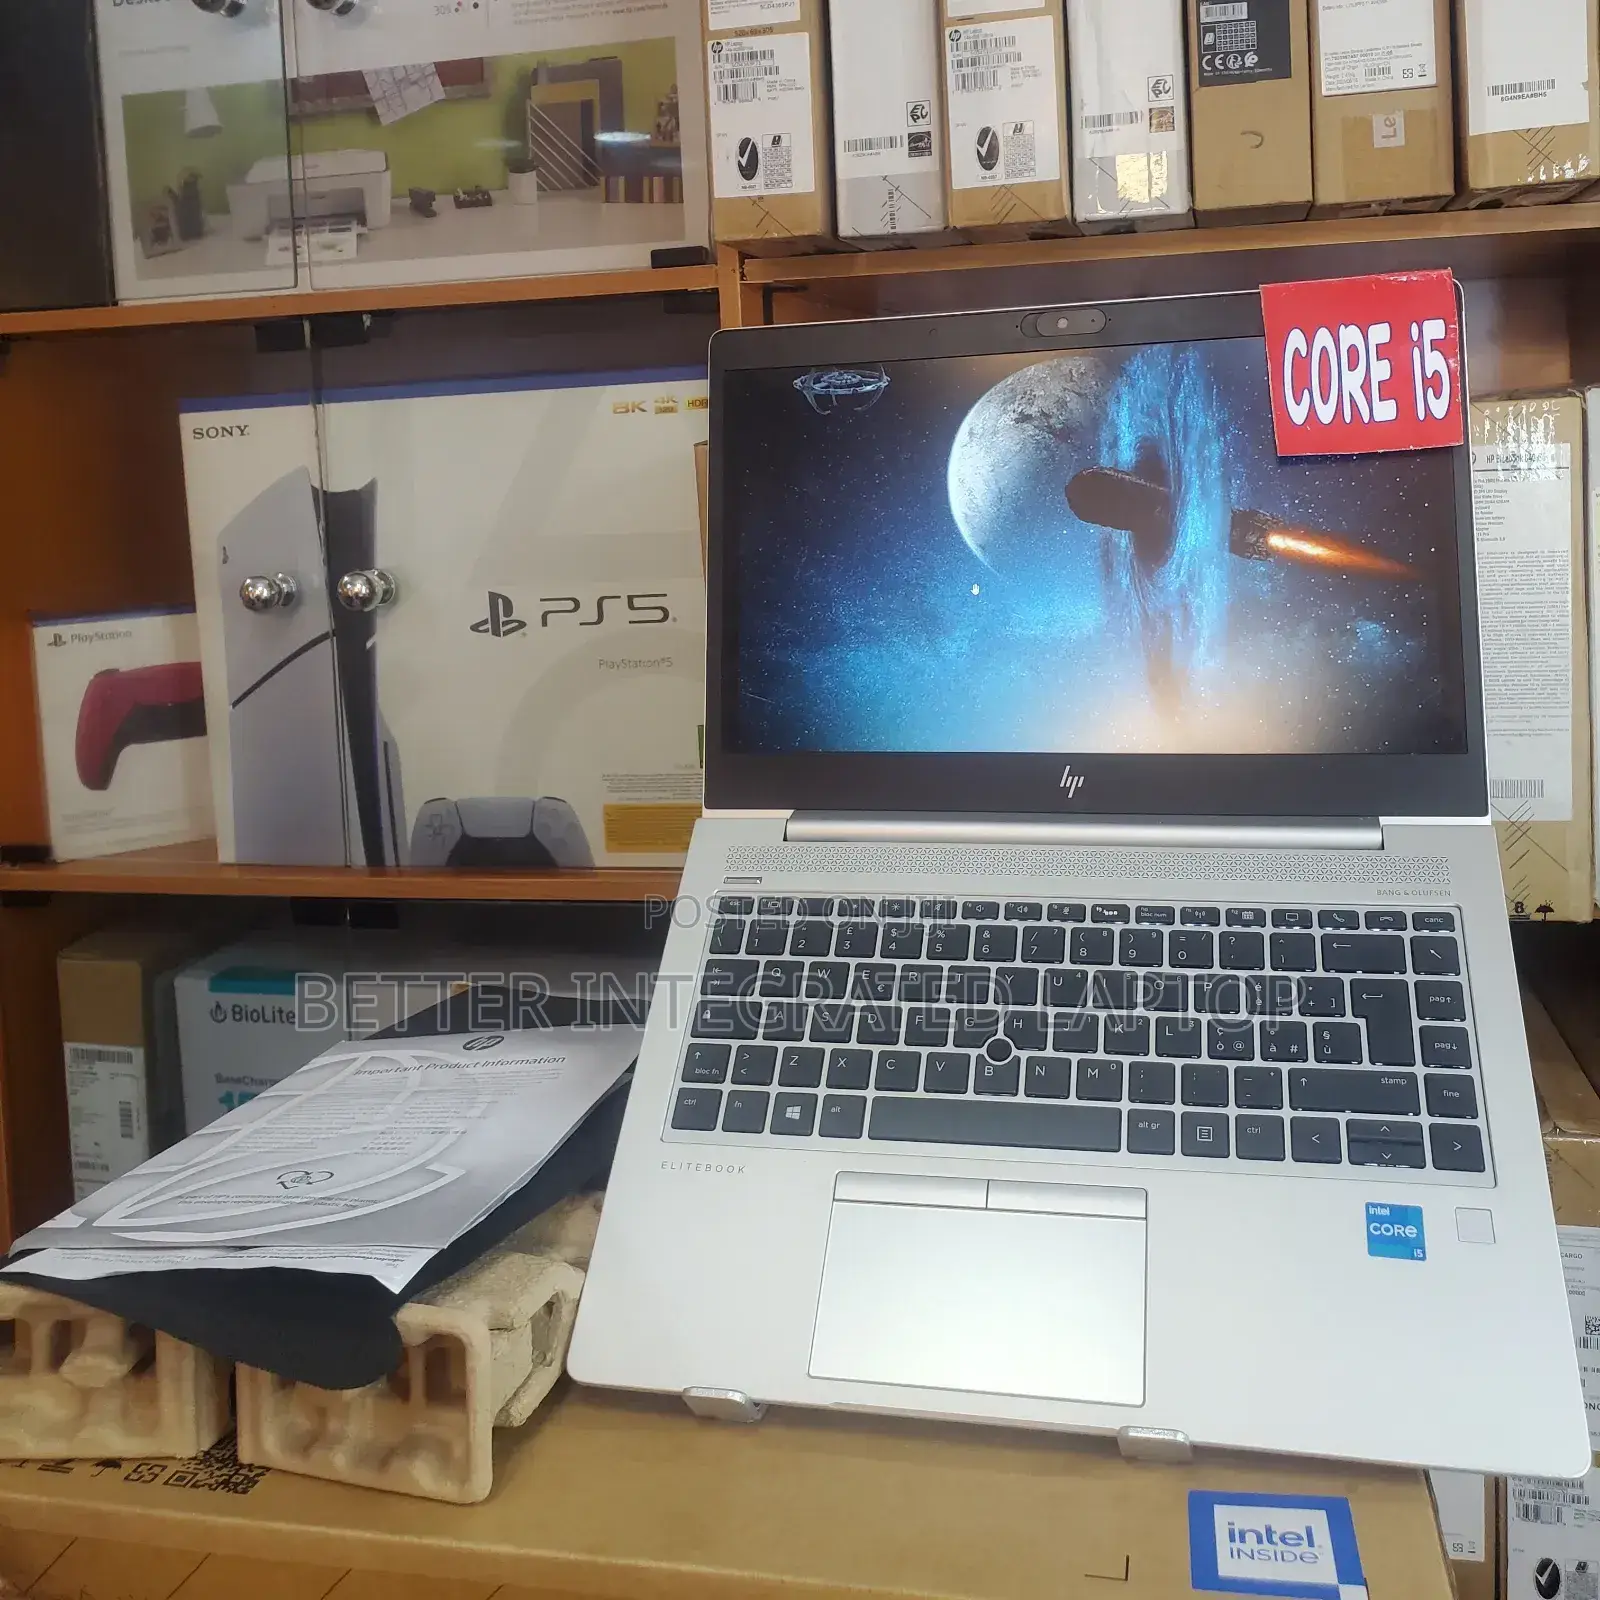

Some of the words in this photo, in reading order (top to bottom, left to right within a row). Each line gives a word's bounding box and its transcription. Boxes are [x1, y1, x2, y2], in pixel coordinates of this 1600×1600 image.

[1283, 322, 1397, 426] CORE
[1410, 318, 1450, 422] i5
[192, 425, 249, 440] SONY
[540, 593, 670, 627] PS5
[70, 630, 133, 644] PlayStation
[1059, 765, 1084, 798] hp
[1411, 889, 1451, 897] OLUFSEN
[797, 939, 806, 948] 2
[843, 940, 851, 950] 3
[888, 941, 897, 951] 4
[935, 943, 943, 952] 5
[982, 944, 990, 954] 6
[1030, 946, 1038, 955] 7
[1079, 947, 1088, 957] 8
[1128, 949, 1137, 959] 9
[771, 967, 782, 977] Q
[817, 968, 831, 979] W
[862, 969, 871, 980] E
[908, 972, 918, 982] R
[956, 973, 964, 983] T
[1005, 974, 1015, 984] Y
[1053, 976, 1063, 986] U
[1203, 982, 1213, 992] P
[231, 1003, 297, 1026] BioLite
[774, 1010, 784, 1020] A
[821, 1012, 830, 1022] S
[867, 1013, 877, 1024] D
[915, 1015, 924, 1025] F
[965, 1017, 975, 1027] G
[1013, 1018, 1023, 1029] H
[1063, 1021, 1070, 1031] J
[1114, 1023, 1124, 1034] K
[1165, 1025, 1174, 1036] L
[1232, 1040, 1245, 1051] @
[1290, 1044, 1299, 1054] #
[353, 1063, 423, 1077] Important
[424, 1061, 481, 1072] Product
[482, 1056, 566, 1069] Information
[790, 1055, 799, 1066] Z
[837, 1057, 847, 1068] X
[886, 1059, 896, 1070] C
[935, 1061, 946, 1072] V
[984, 1065, 994, 1076] B
[1035, 1066, 1046, 1076] N
[1087, 1068, 1099, 1079] M
[1381, 1077, 1407, 1086] stamp
[711, 1067, 720, 1075] fn
[1443, 1089, 1460, 1098] fine
[684, 1098, 697, 1106] ctrl
[734, 1100, 742, 1108] fn
[830, 1105, 841, 1113] alt
[1151, 1122, 1161, 1130] gr
[1246, 1126, 1261, 1135] ctrl
[661, 1161, 746, 1174] ELITEBOOK
[1368, 1206, 1391, 1216] intel
[1413, 1248, 1424, 1258] i5
[1227, 1521, 1318, 1548] intel
